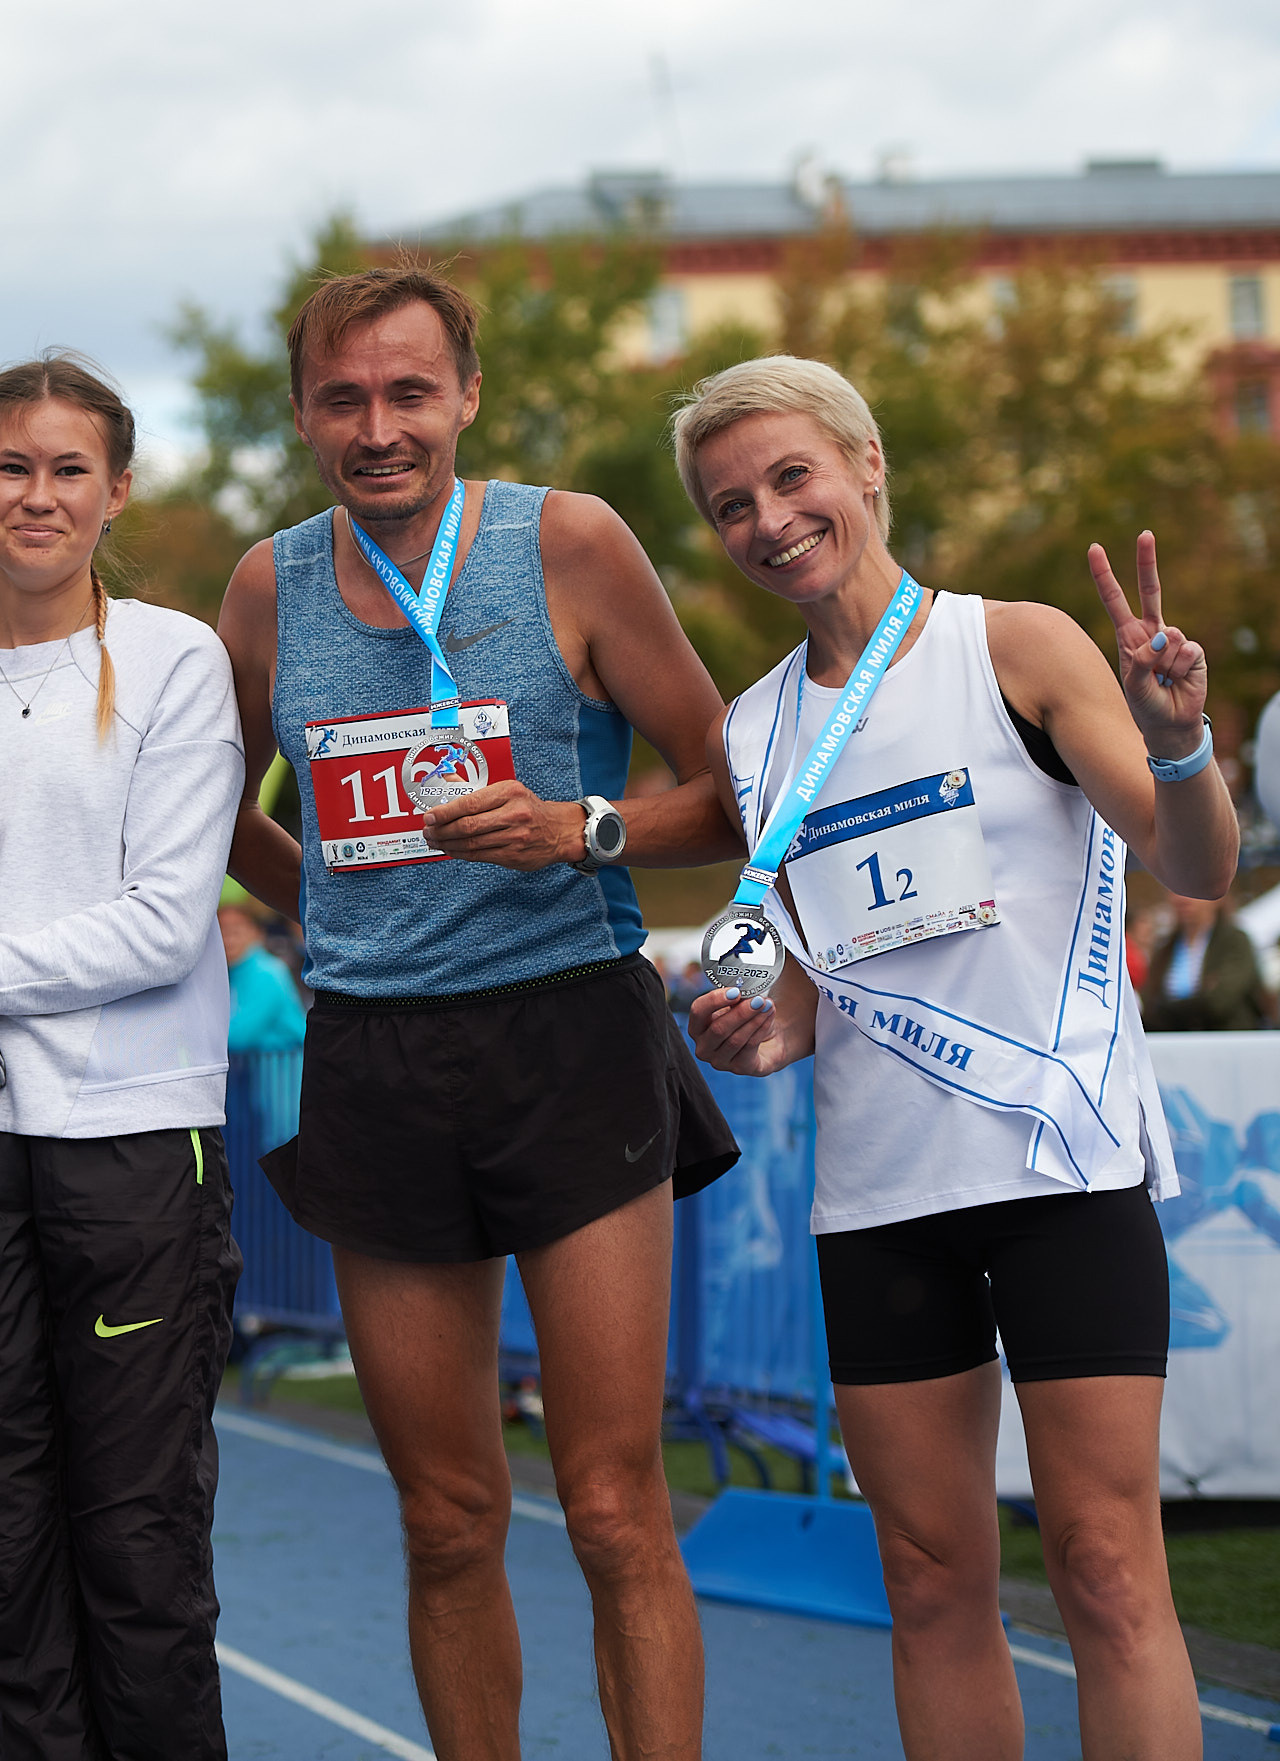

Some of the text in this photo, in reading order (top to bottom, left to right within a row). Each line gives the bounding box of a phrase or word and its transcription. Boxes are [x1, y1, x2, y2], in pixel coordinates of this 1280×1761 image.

[796, 579, 920, 802] ДИНАМОВСКАЯ МИЛЯ 2023
[342, 728, 426, 748] Динамовская
[807, 794, 931, 843] Динамовская миля
[743, 868, 775, 883] ИЖЕВСК
[1076, 827, 1116, 1011] Динамов
[717, 966, 769, 979] 1923-2023
